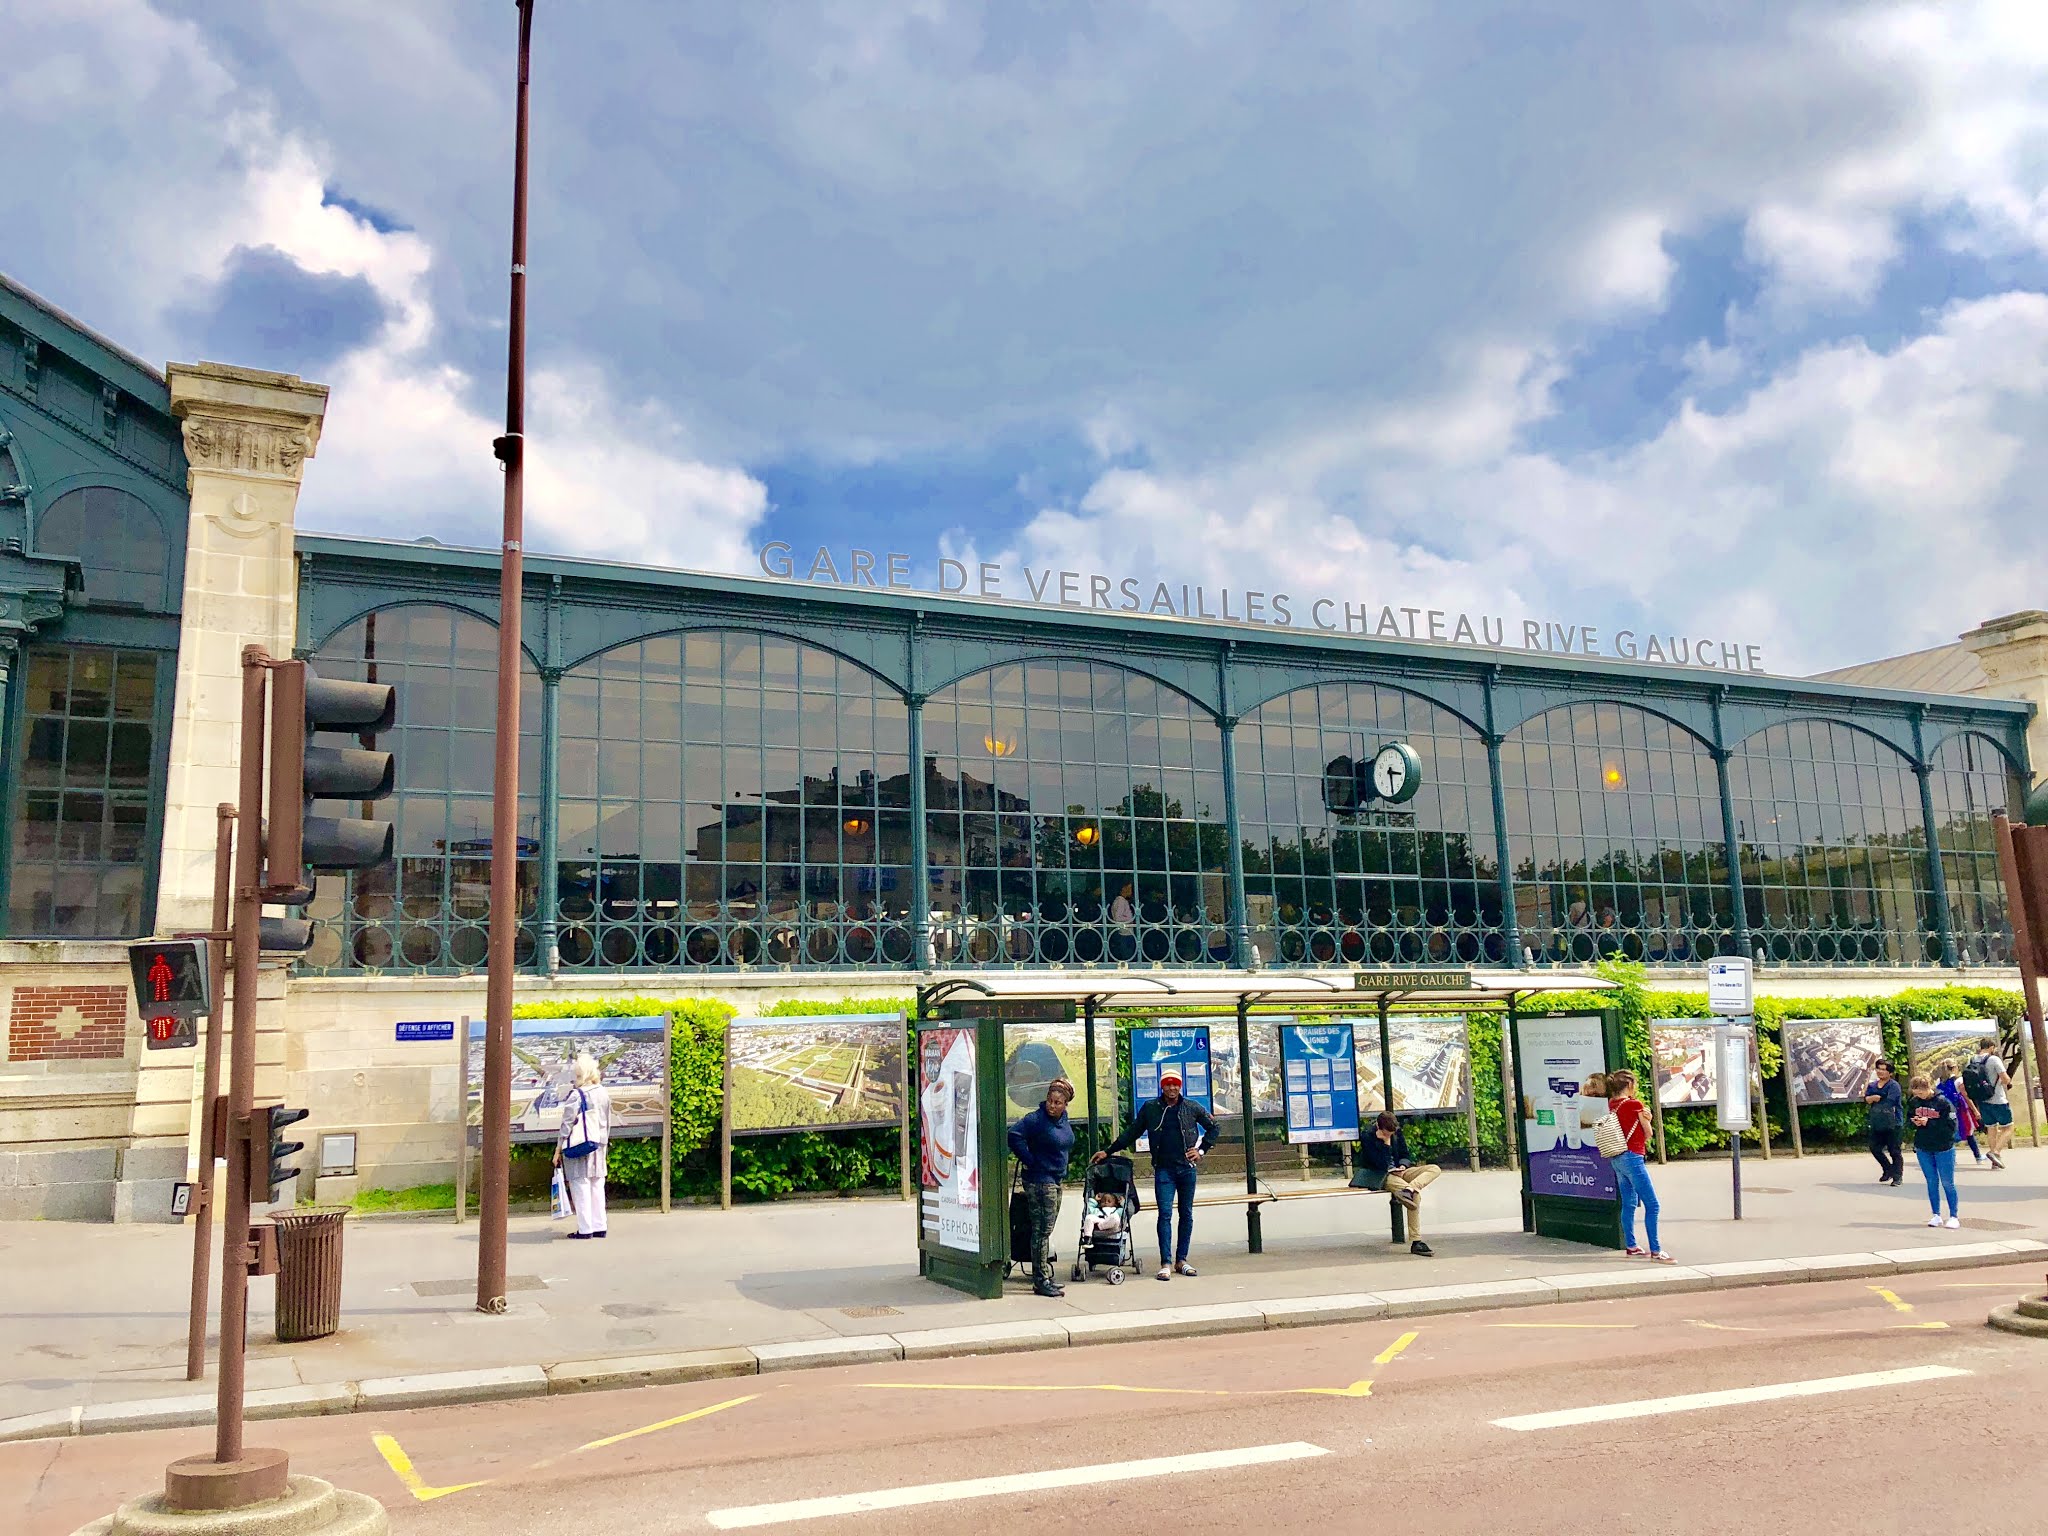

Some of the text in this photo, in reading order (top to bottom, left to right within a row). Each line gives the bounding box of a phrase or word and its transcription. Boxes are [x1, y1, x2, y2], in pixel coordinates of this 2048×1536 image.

[759, 540, 1766, 672] GARE DE VERSAILLES CHATEAU RIVE GAUCHE
[1359, 974, 1466, 987] GARE RIVE GAUCHE
[1144, 1030, 1195, 1038] HORAIRES DES
[1293, 1027, 1340, 1036] HORAIRES DES
[1157, 1039, 1183, 1047] LIGNES
[1305, 1036, 1329, 1044] LIGNES
[1550, 1171, 1595, 1186] cellublue
[941, 1218, 979, 1236] SEPHORA
